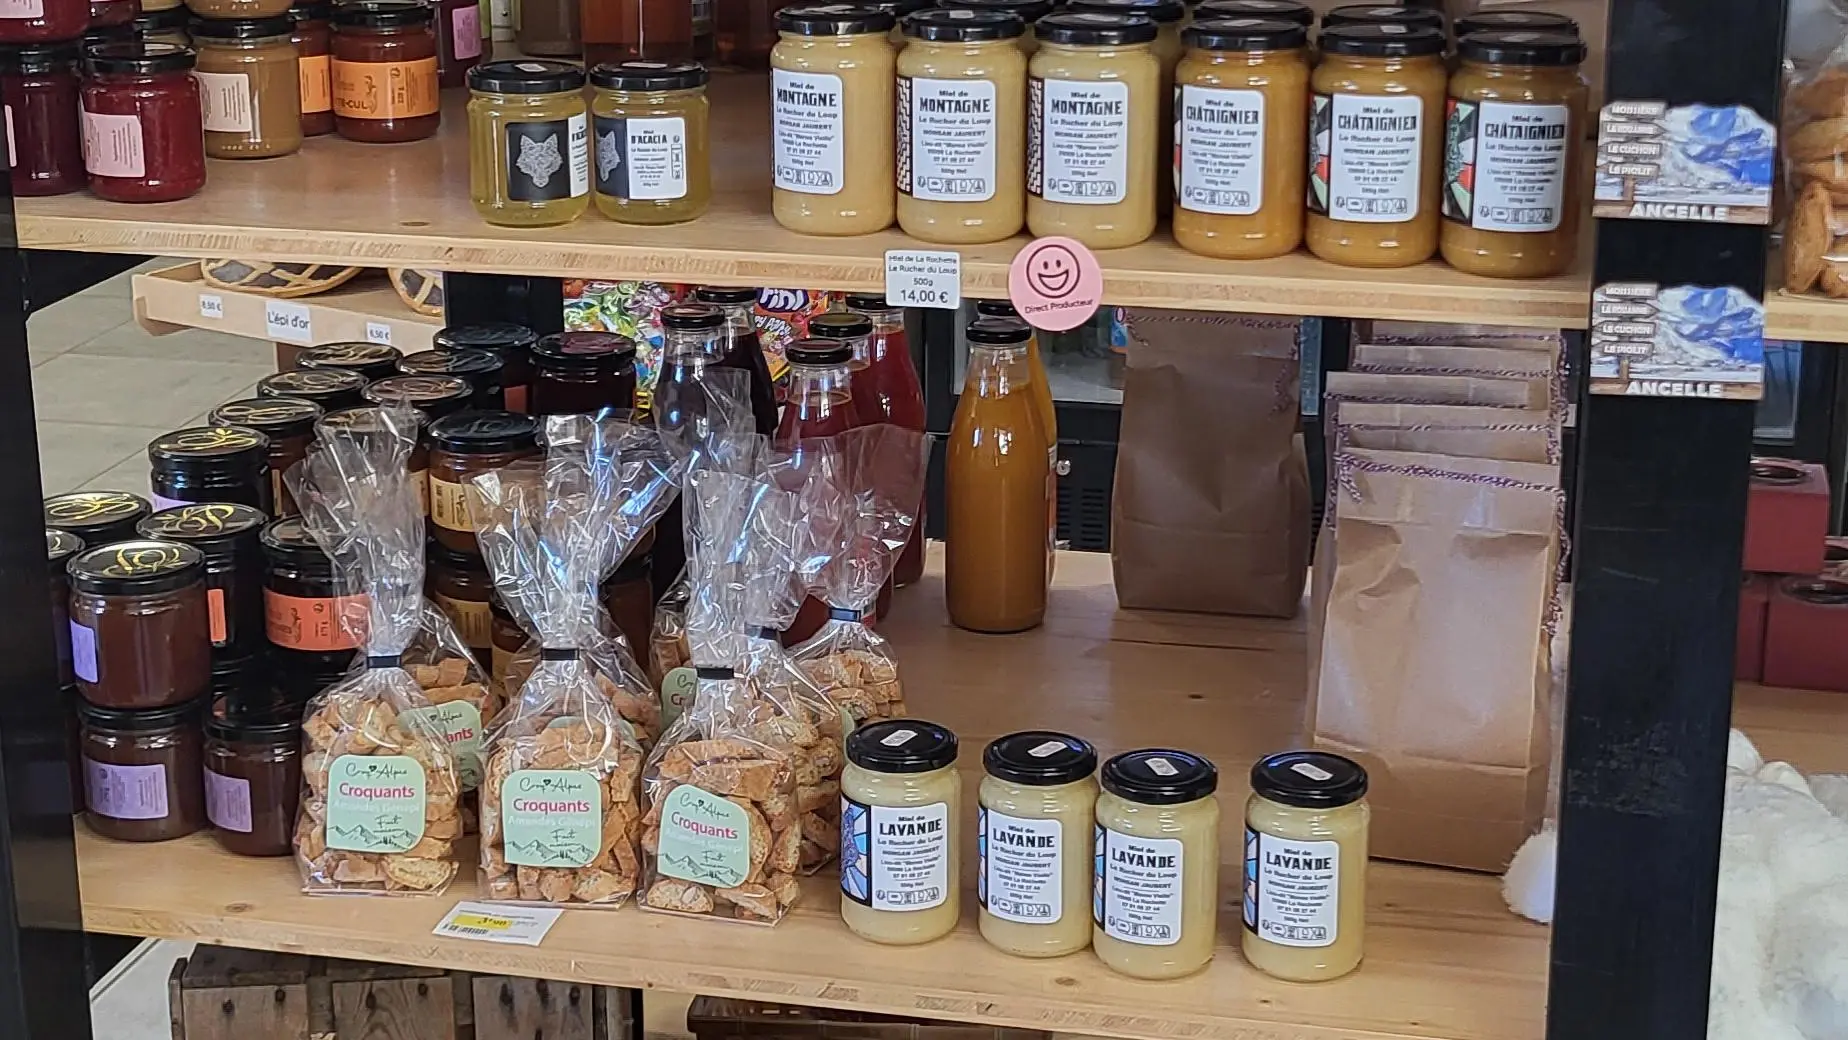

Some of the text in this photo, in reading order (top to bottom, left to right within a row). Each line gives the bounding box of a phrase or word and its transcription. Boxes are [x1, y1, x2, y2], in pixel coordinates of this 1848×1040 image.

[777, 88, 836, 106] MONTAGNE
[920, 97, 990, 113] MONTAGNE
[1051, 99, 1122, 115] MONTAGNE
[1187, 106, 1258, 124] CHÂTAIGNIER
[1338, 115, 1416, 131] CHÂTAIGNIER
[1629, 203, 1727, 220] ANCELLE
[913, 278, 933, 286] 500g
[901, 290, 948, 303] 14,00 €
[1025, 305, 1048, 313] Direct
[268, 311, 309, 329] L'épi d'or
[1625, 382, 1722, 396] ANCELLE
[339, 783, 415, 800] Croquants
[513, 798, 590, 815] Croquants
[672, 812, 738, 839] Croquants
[880, 819, 941, 836] LAVANDE
[993, 828, 1055, 848] LAVANDE
[1112, 848, 1175, 868] LAVANDE
[1266, 851, 1332, 870] LAVANDE
